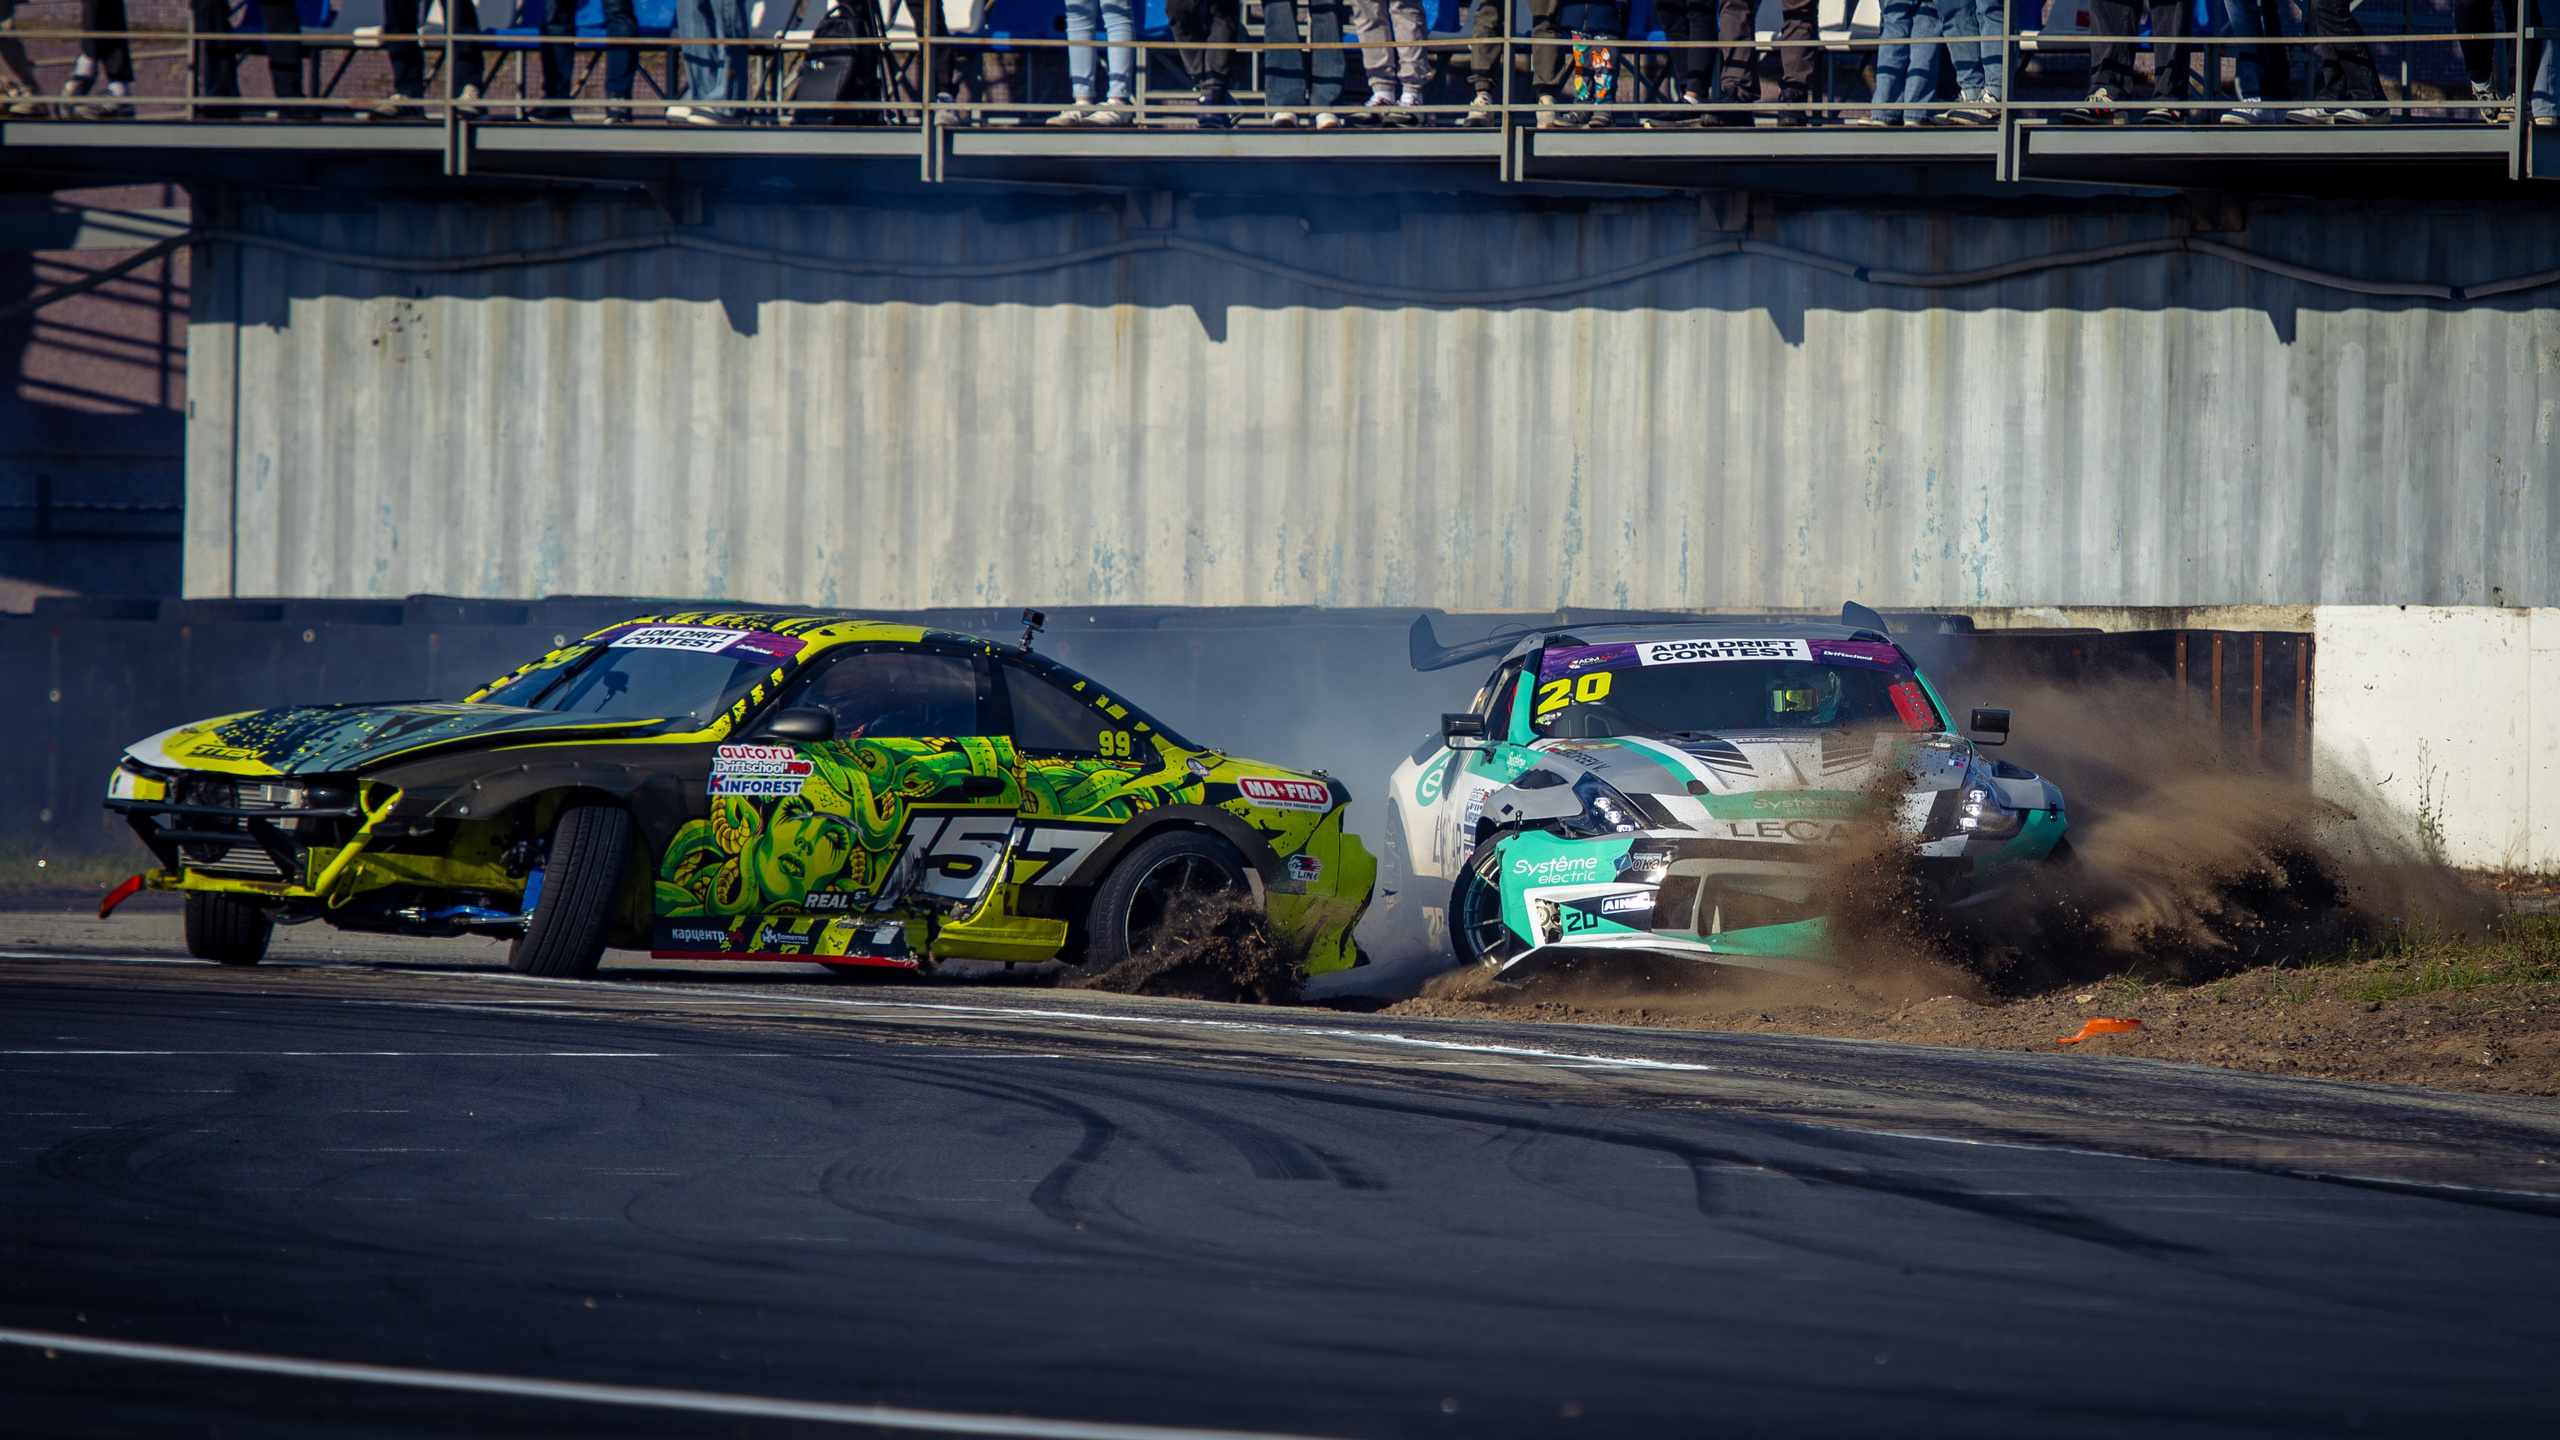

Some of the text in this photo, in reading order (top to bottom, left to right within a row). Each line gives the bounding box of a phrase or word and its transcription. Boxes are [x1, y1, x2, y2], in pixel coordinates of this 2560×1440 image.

[634, 628, 737, 641] ADM DRIFT
[620, 636, 725, 649] CONTEST
[1650, 640, 1796, 653] ADM DRIFT
[1651, 648, 1799, 662] CONTEST
[1537, 671, 1613, 716] 20
[1098, 730, 1131, 757] 99
[719, 745, 794, 761] auto.ru
[715, 760, 812, 775] Driftschool.PRO
[1538, 869, 1597, 884] electric
[803, 893, 849, 909] REAL
[1565, 909, 1599, 933] 20
